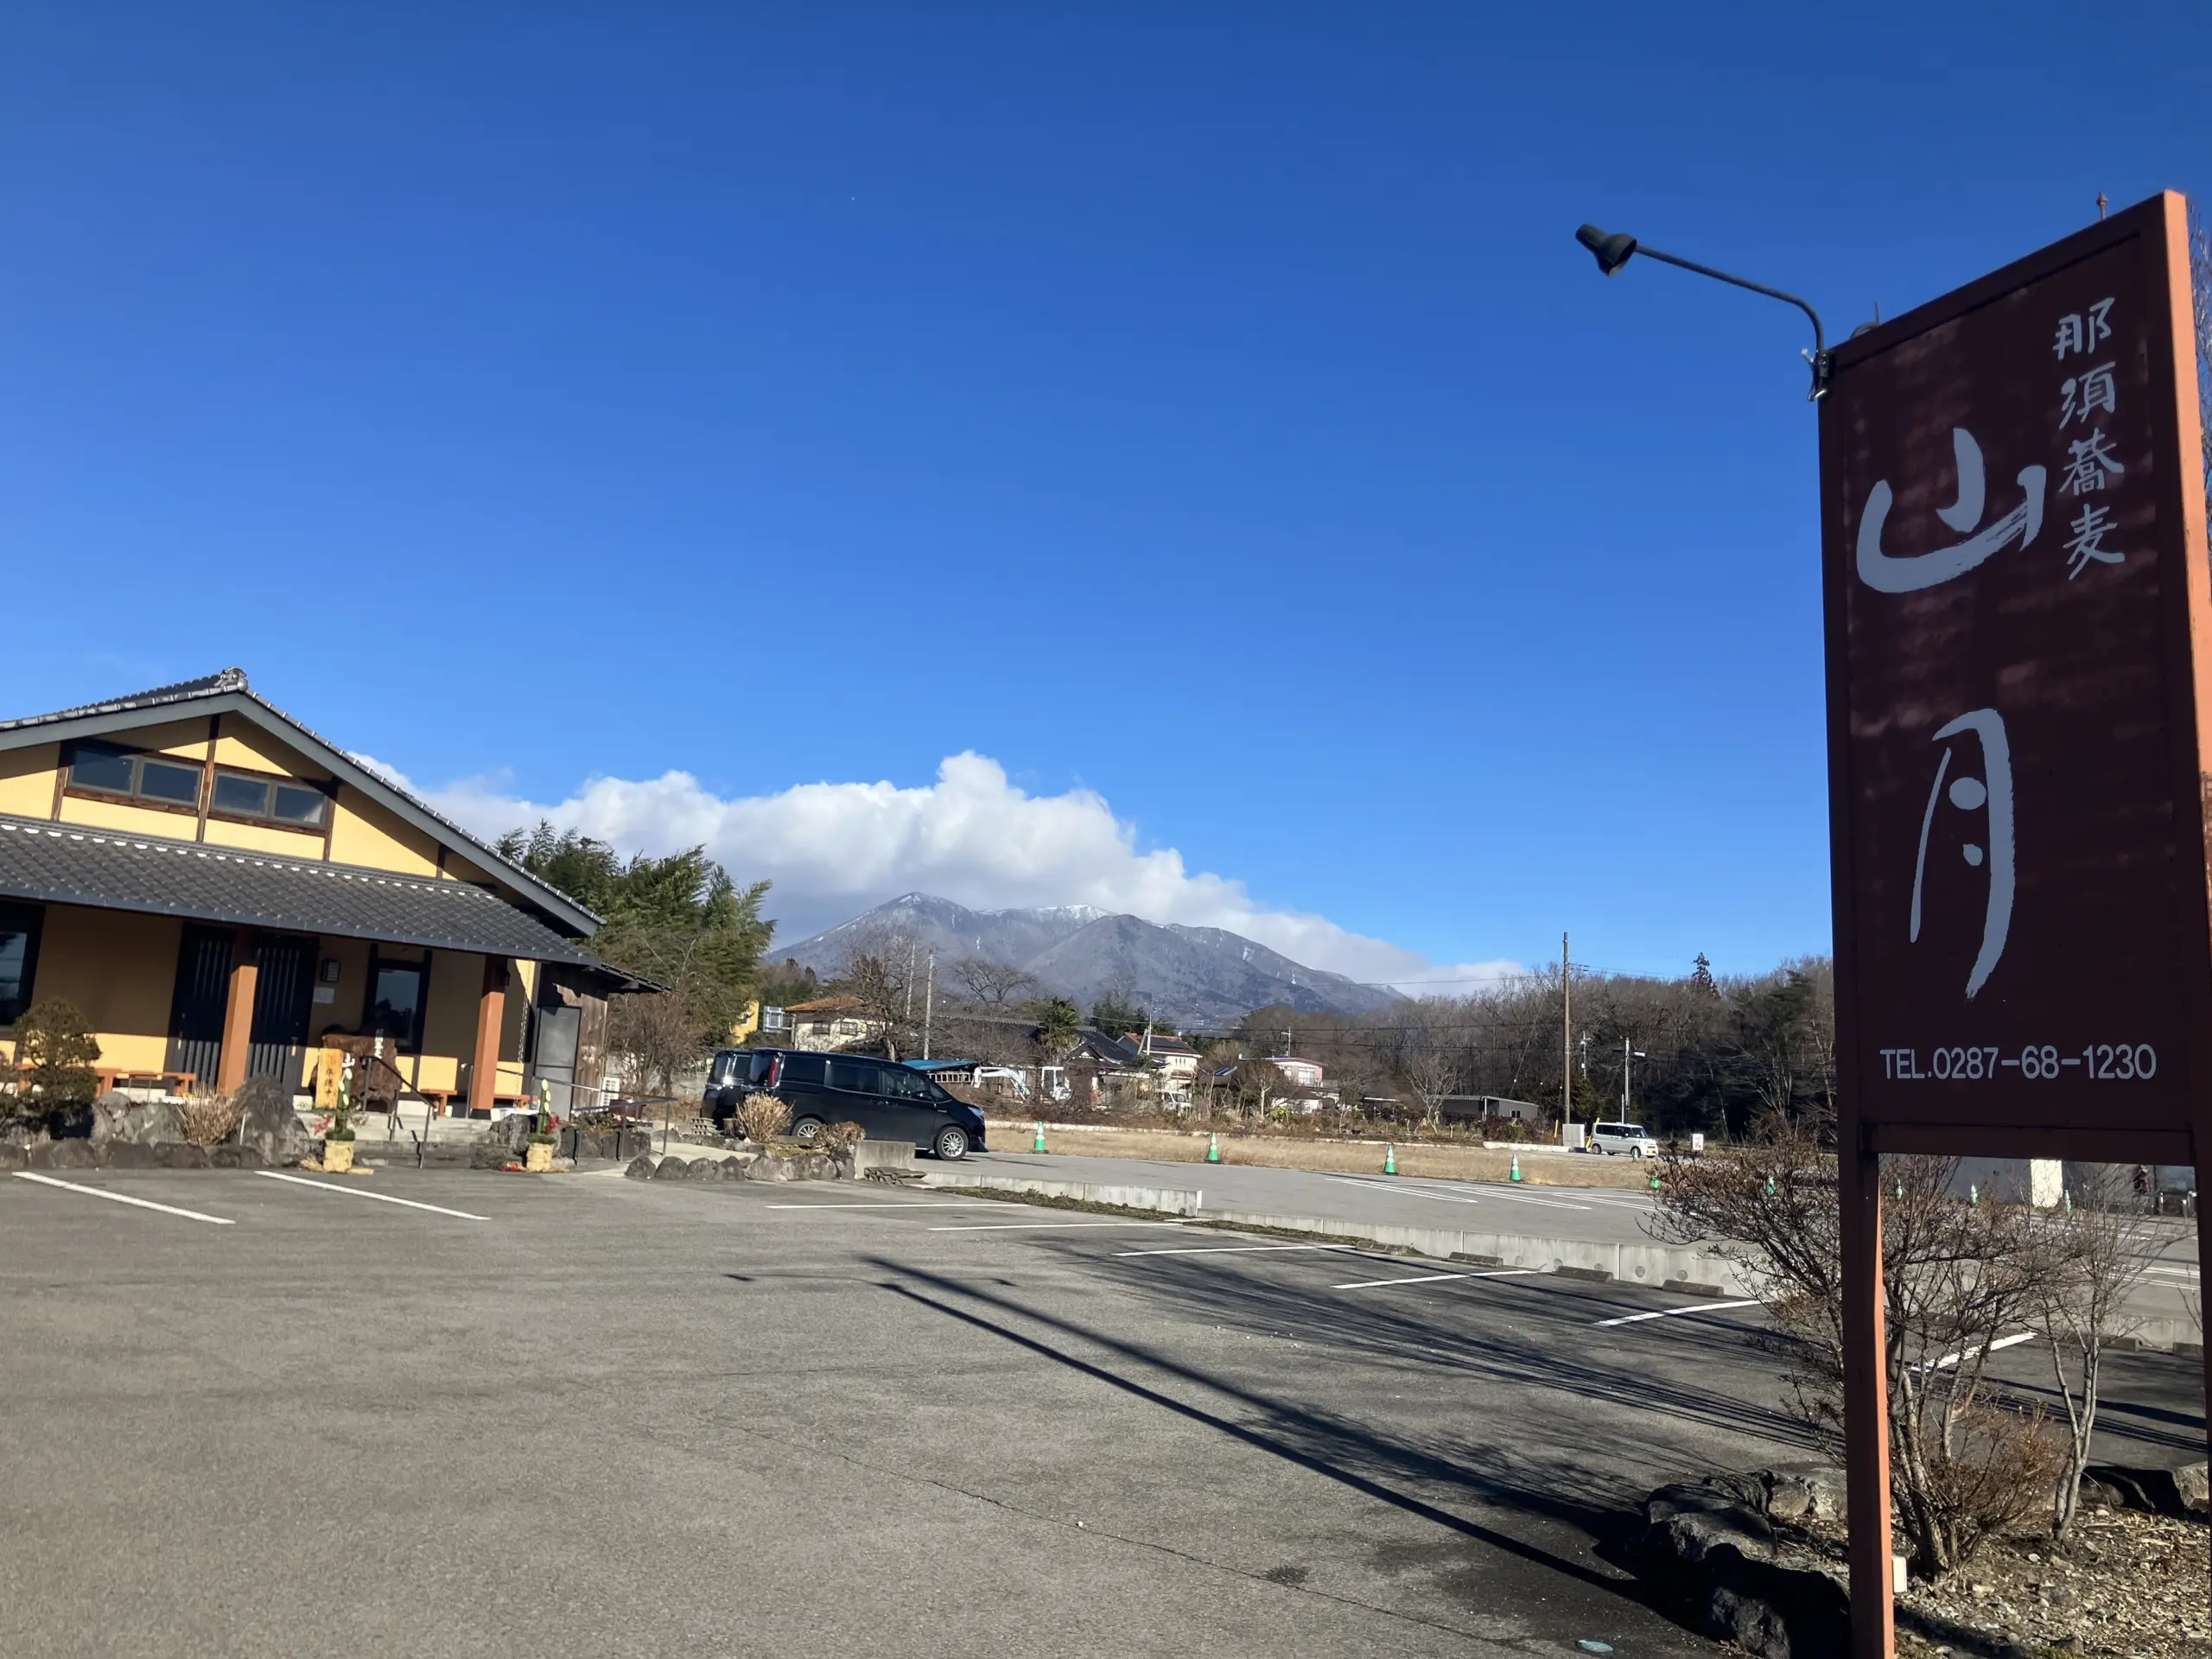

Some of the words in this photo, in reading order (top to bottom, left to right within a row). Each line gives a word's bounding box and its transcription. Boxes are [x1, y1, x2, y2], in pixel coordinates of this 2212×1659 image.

[2052, 296, 2126, 582] 那須蕎麦
[1856, 427, 2048, 1000] 山月
[1879, 1044, 2158, 1080] TEL.0287-68-1230
